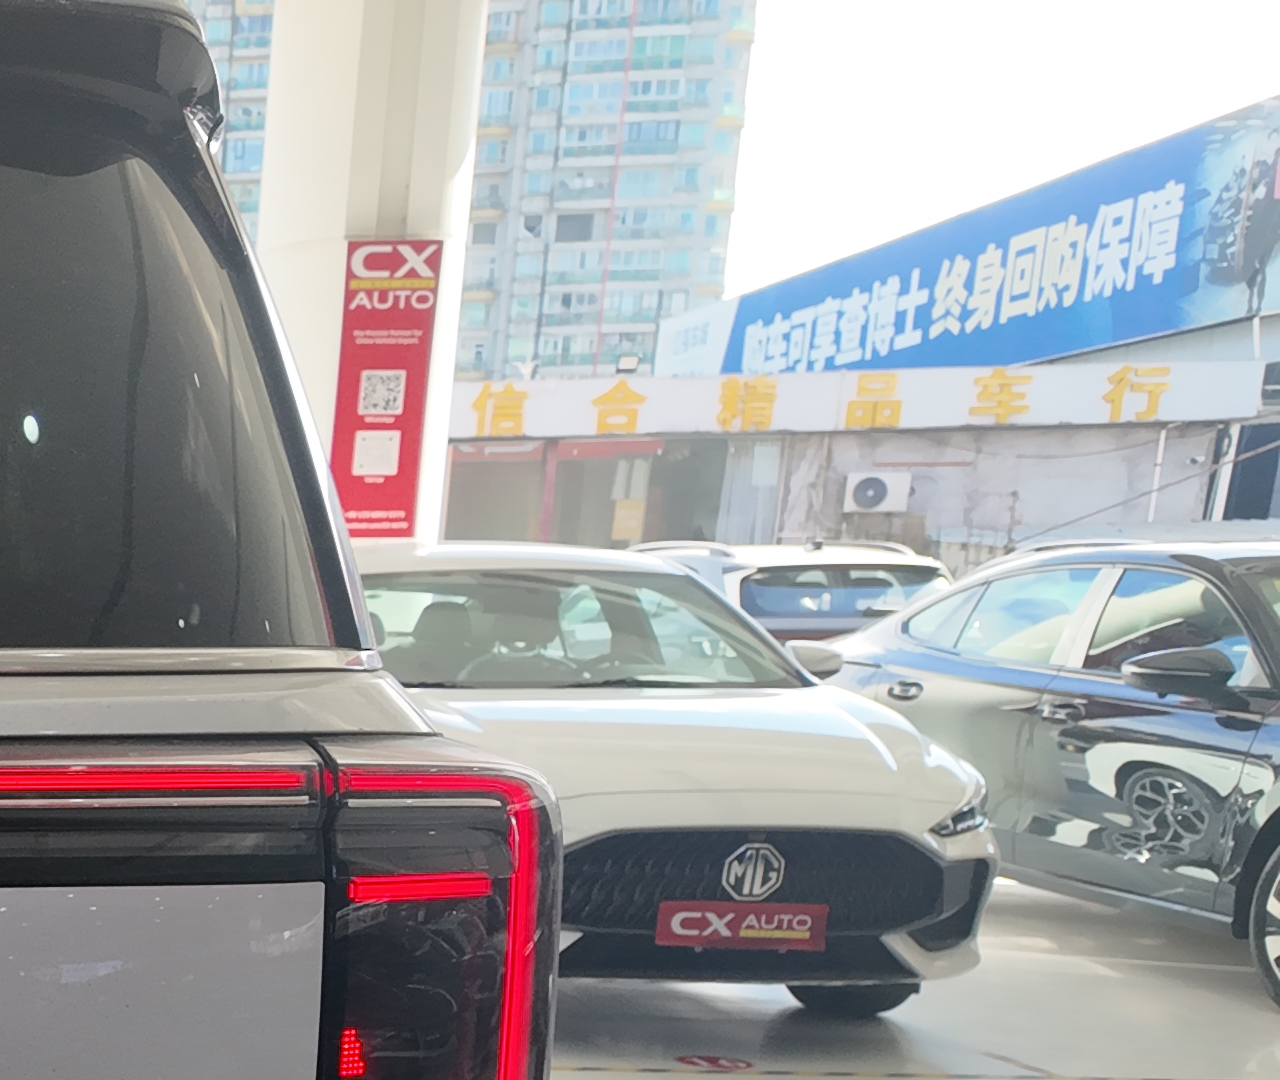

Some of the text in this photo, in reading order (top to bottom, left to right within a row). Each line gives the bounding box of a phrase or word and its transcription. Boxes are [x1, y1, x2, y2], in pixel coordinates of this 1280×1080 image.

[350, 244, 439, 278] CX
[928, 180, 1186, 340] 终身回购保障
[348, 289, 435, 310] AUTO
[472, 366, 1171, 437] 信合精品车行
[728, 849, 779, 896] MG
[670, 911, 813, 938] CX AUTO
